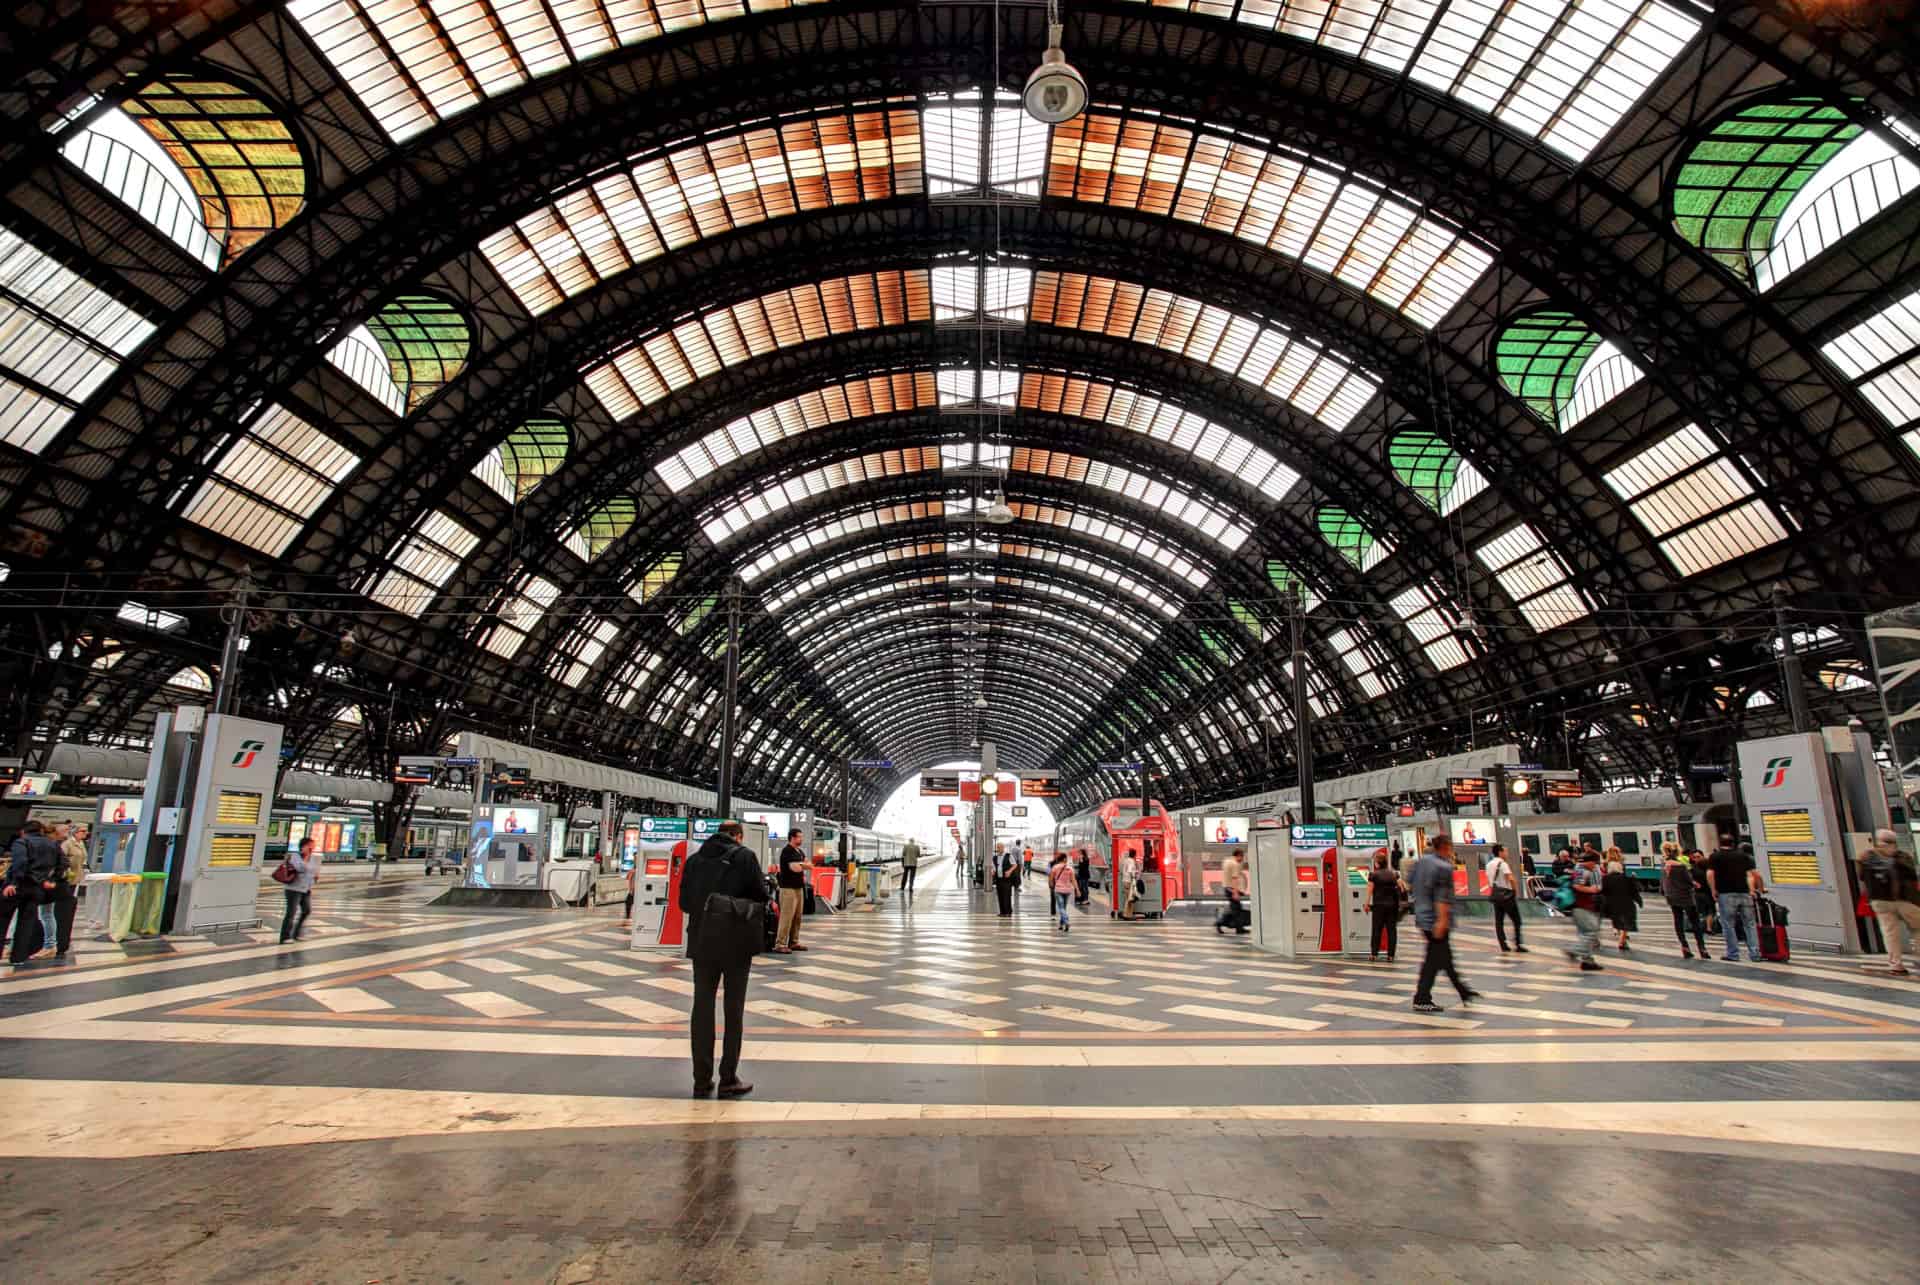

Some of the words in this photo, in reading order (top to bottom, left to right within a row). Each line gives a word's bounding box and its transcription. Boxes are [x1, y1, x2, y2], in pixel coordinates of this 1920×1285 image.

[480, 807, 489, 816] 11
[794, 812, 807, 822] 12
[1187, 816, 1200, 827] 13
[1498, 818, 1511, 828] 14
